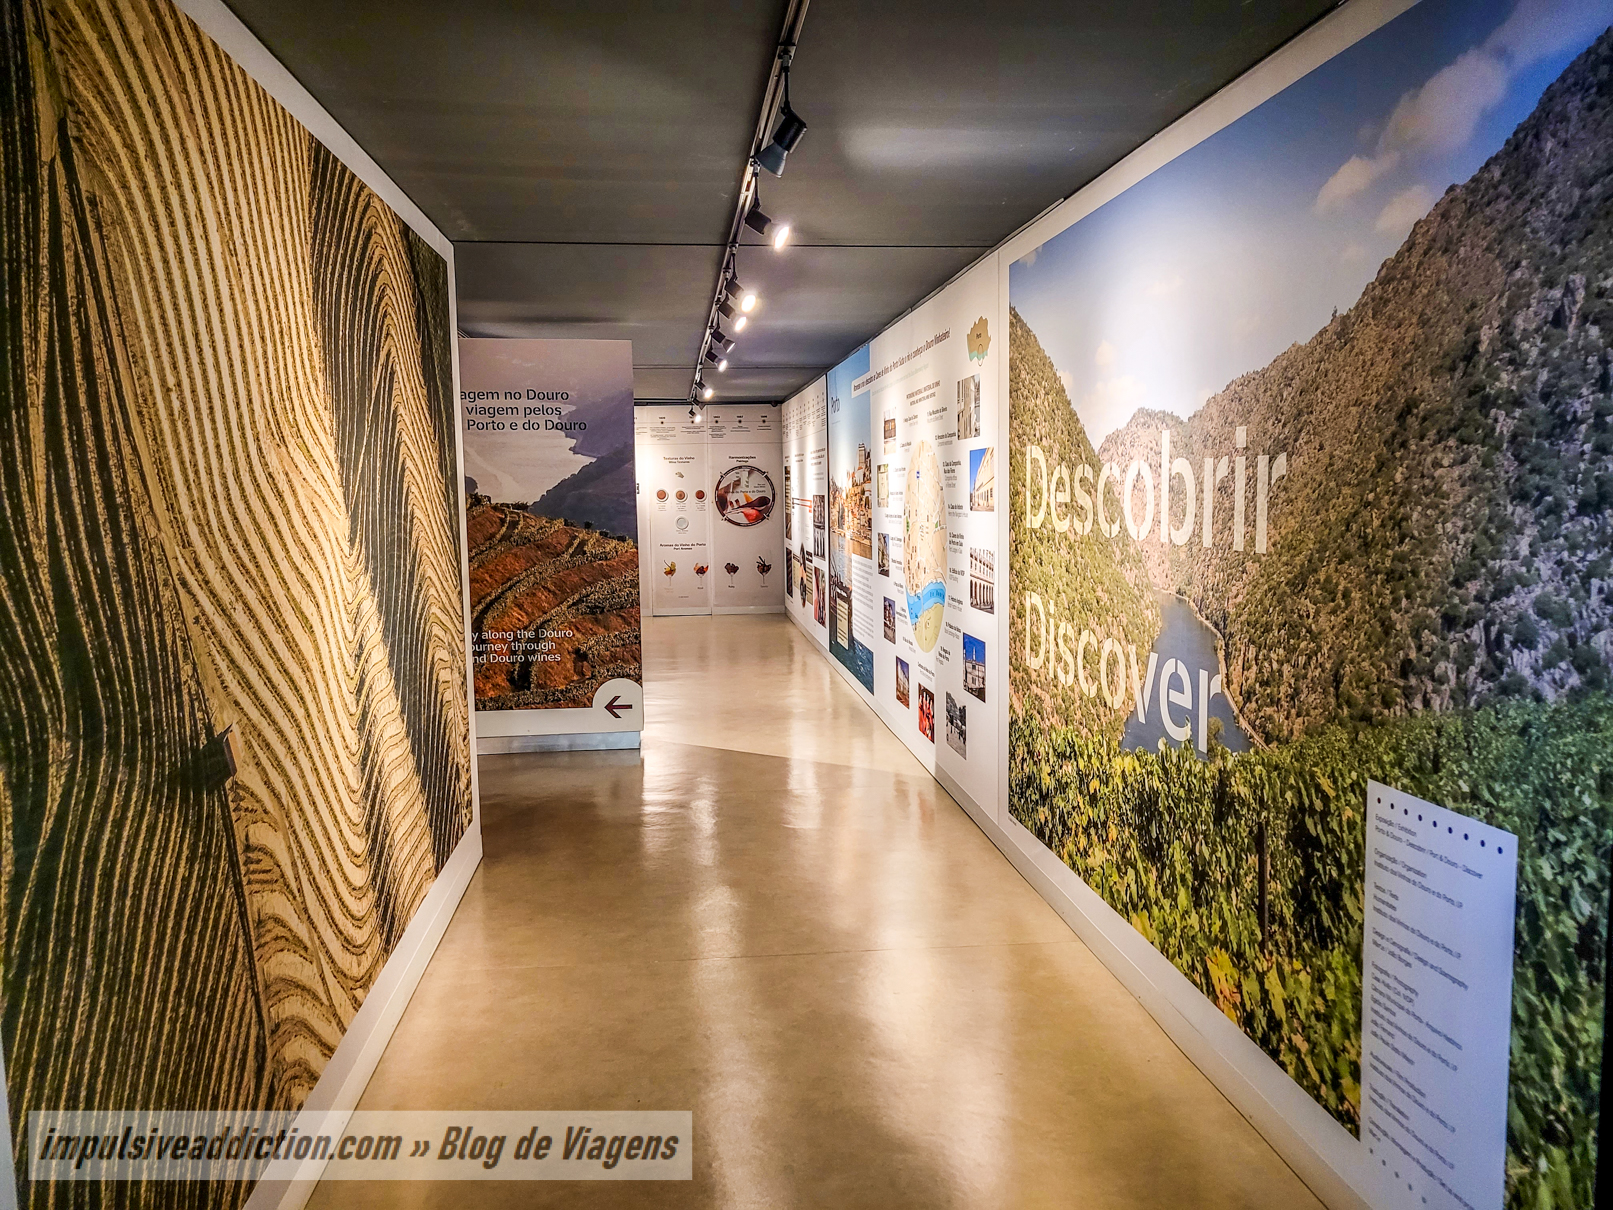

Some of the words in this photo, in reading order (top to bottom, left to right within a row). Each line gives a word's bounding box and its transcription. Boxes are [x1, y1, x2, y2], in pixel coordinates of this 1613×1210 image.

[504, 391, 522, 400] no
[526, 389, 569, 400] Douro
[466, 404, 519, 418] viagem
[524, 404, 562, 418] pelos
[467, 420, 505, 430] Porto
[510, 422, 518, 430] e
[522, 420, 540, 430] do
[545, 420, 587, 430] Douro
[1026, 426, 1287, 554] Descobrir
[482, 630, 514, 641] along
[517, 629, 535, 638] the
[539, 629, 573, 638] Douro
[511, 641, 556, 652] through
[490, 653, 524, 663] Douro
[527, 653, 561, 662] wines
[1026, 590, 1222, 754] Discover
